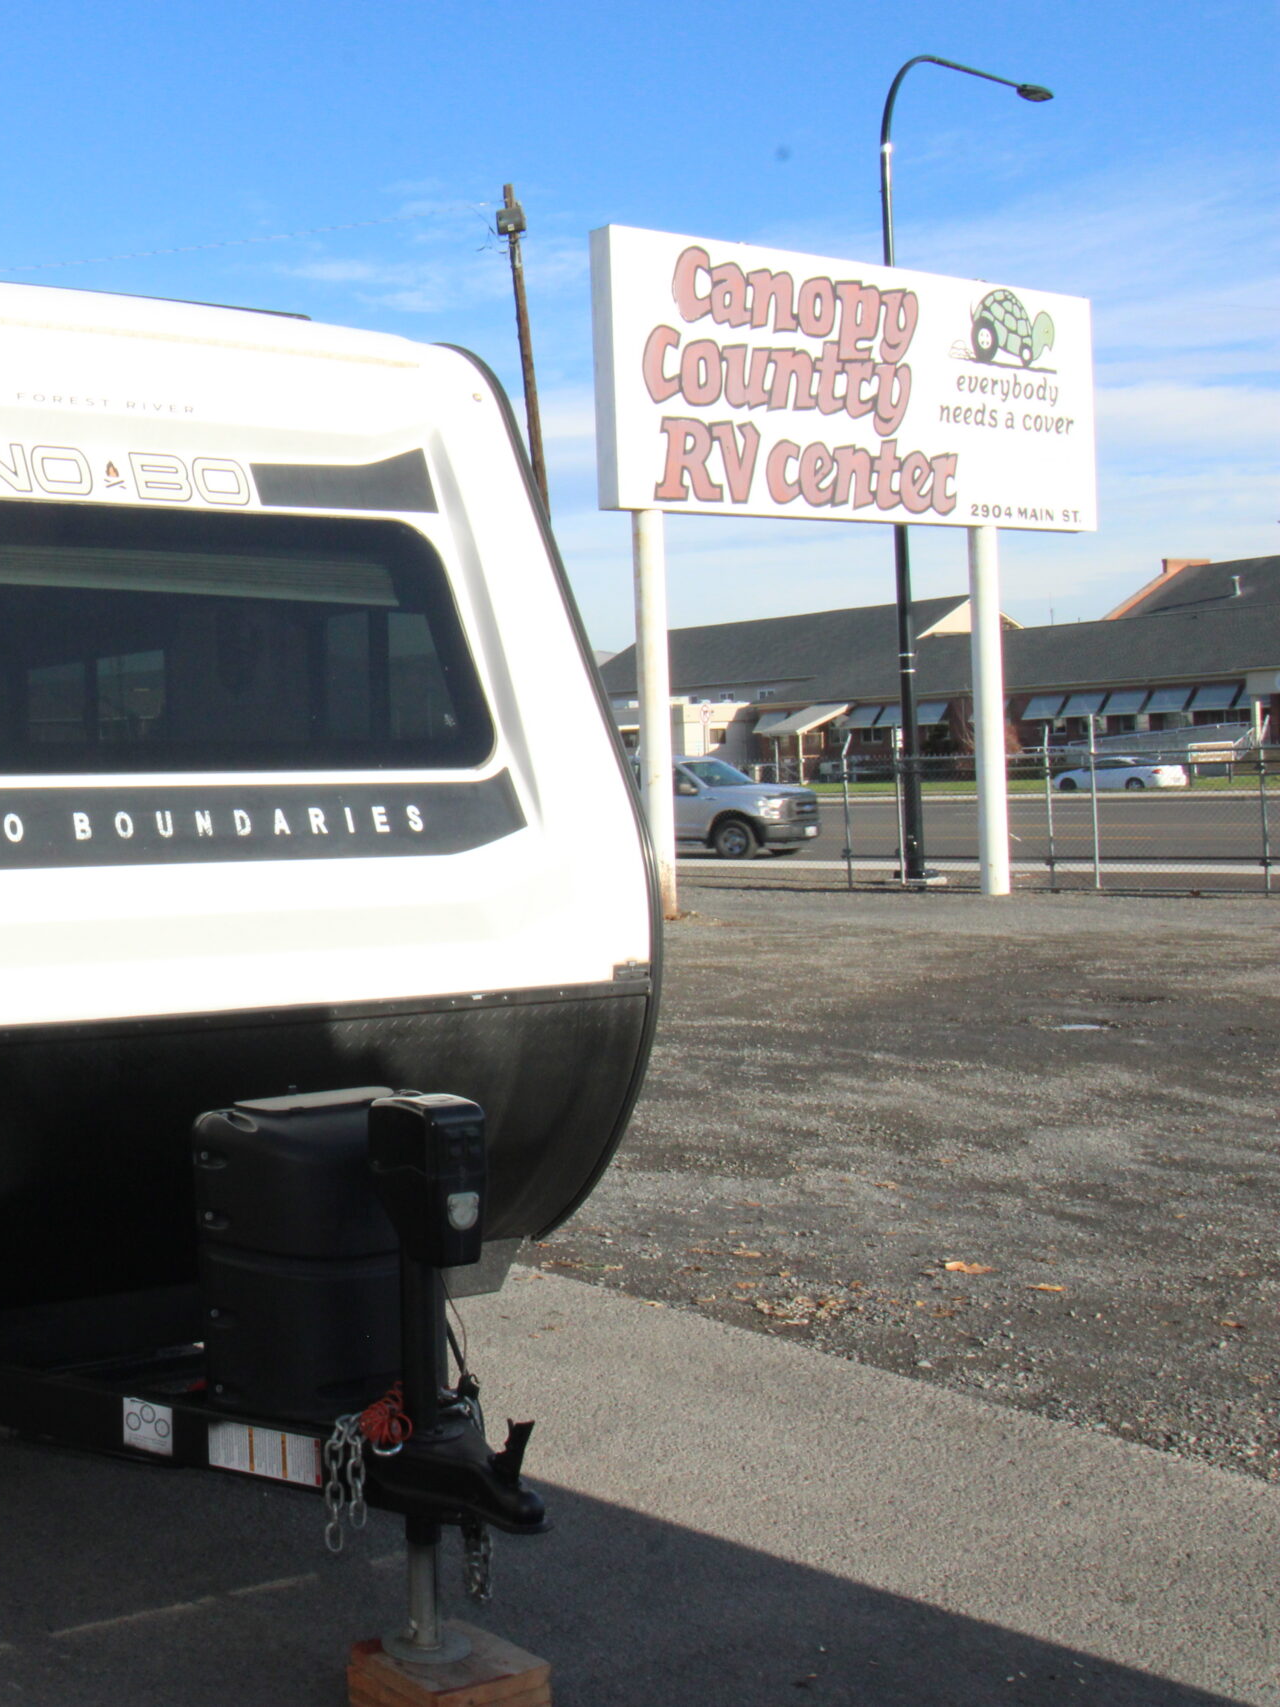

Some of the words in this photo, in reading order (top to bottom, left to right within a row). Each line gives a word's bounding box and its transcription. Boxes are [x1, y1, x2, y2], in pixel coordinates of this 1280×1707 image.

[672, 245, 919, 364] Canopy
[642, 323, 912, 437] Country
[956, 373, 1059, 407] everybody
[16, 391, 109, 408] FOREST
[125, 400, 195, 414] RIVER
[939, 402, 999, 429] needs
[1004, 411, 1015, 430] a
[1022, 413, 1074, 435] cover
[653, 415, 761, 504] RV
[765, 438, 959, 516] center
[970, 503, 1013, 519] 2904
[1017, 507, 1055, 522] MAIN
[1061, 509, 1082, 524] ST.
[72, 804, 425, 841] BOUNDARIES
